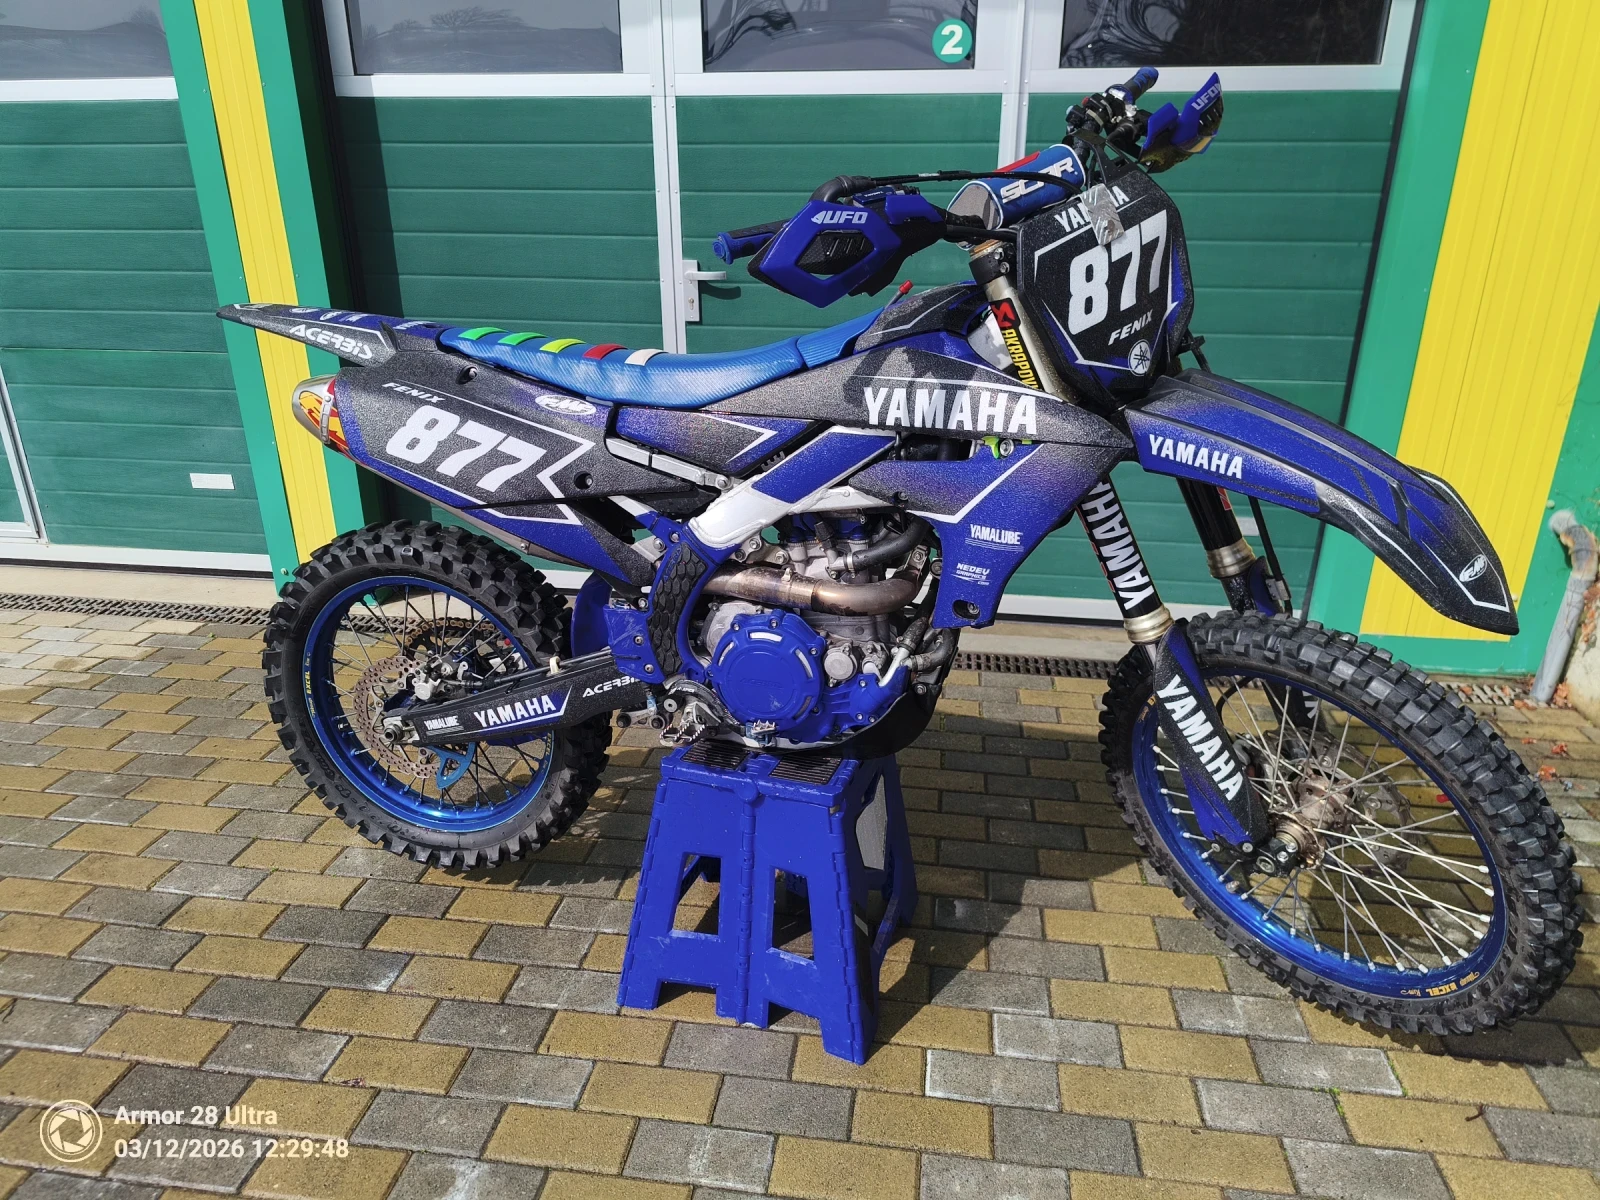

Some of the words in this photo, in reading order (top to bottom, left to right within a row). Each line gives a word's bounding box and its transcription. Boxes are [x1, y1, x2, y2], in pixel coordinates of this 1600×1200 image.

[941, 24, 963, 55] 2
[1191, 84, 1219, 111] UFO
[821, 211, 868, 225] UFO
[1068, 209, 1167, 335] 877
[1108, 310, 1153, 346] FENIX
[1002, 328, 1039, 389] AKRAPOV
[382, 382, 446, 404] FENIX
[864, 387, 1037, 435] YAMAHA
[386, 405, 548, 493] 877
[1149, 433, 1243, 480] YAMAHA
[969, 523, 1022, 545] YAMALUBE
[956, 562, 991, 576] NEDEV
[424, 715, 460, 731] YAMALUBE
[473, 694, 557, 729] YAMAHA
[1156, 674, 1244, 801] YAMAHA
[1425, 982, 1459, 997] EXCEL
